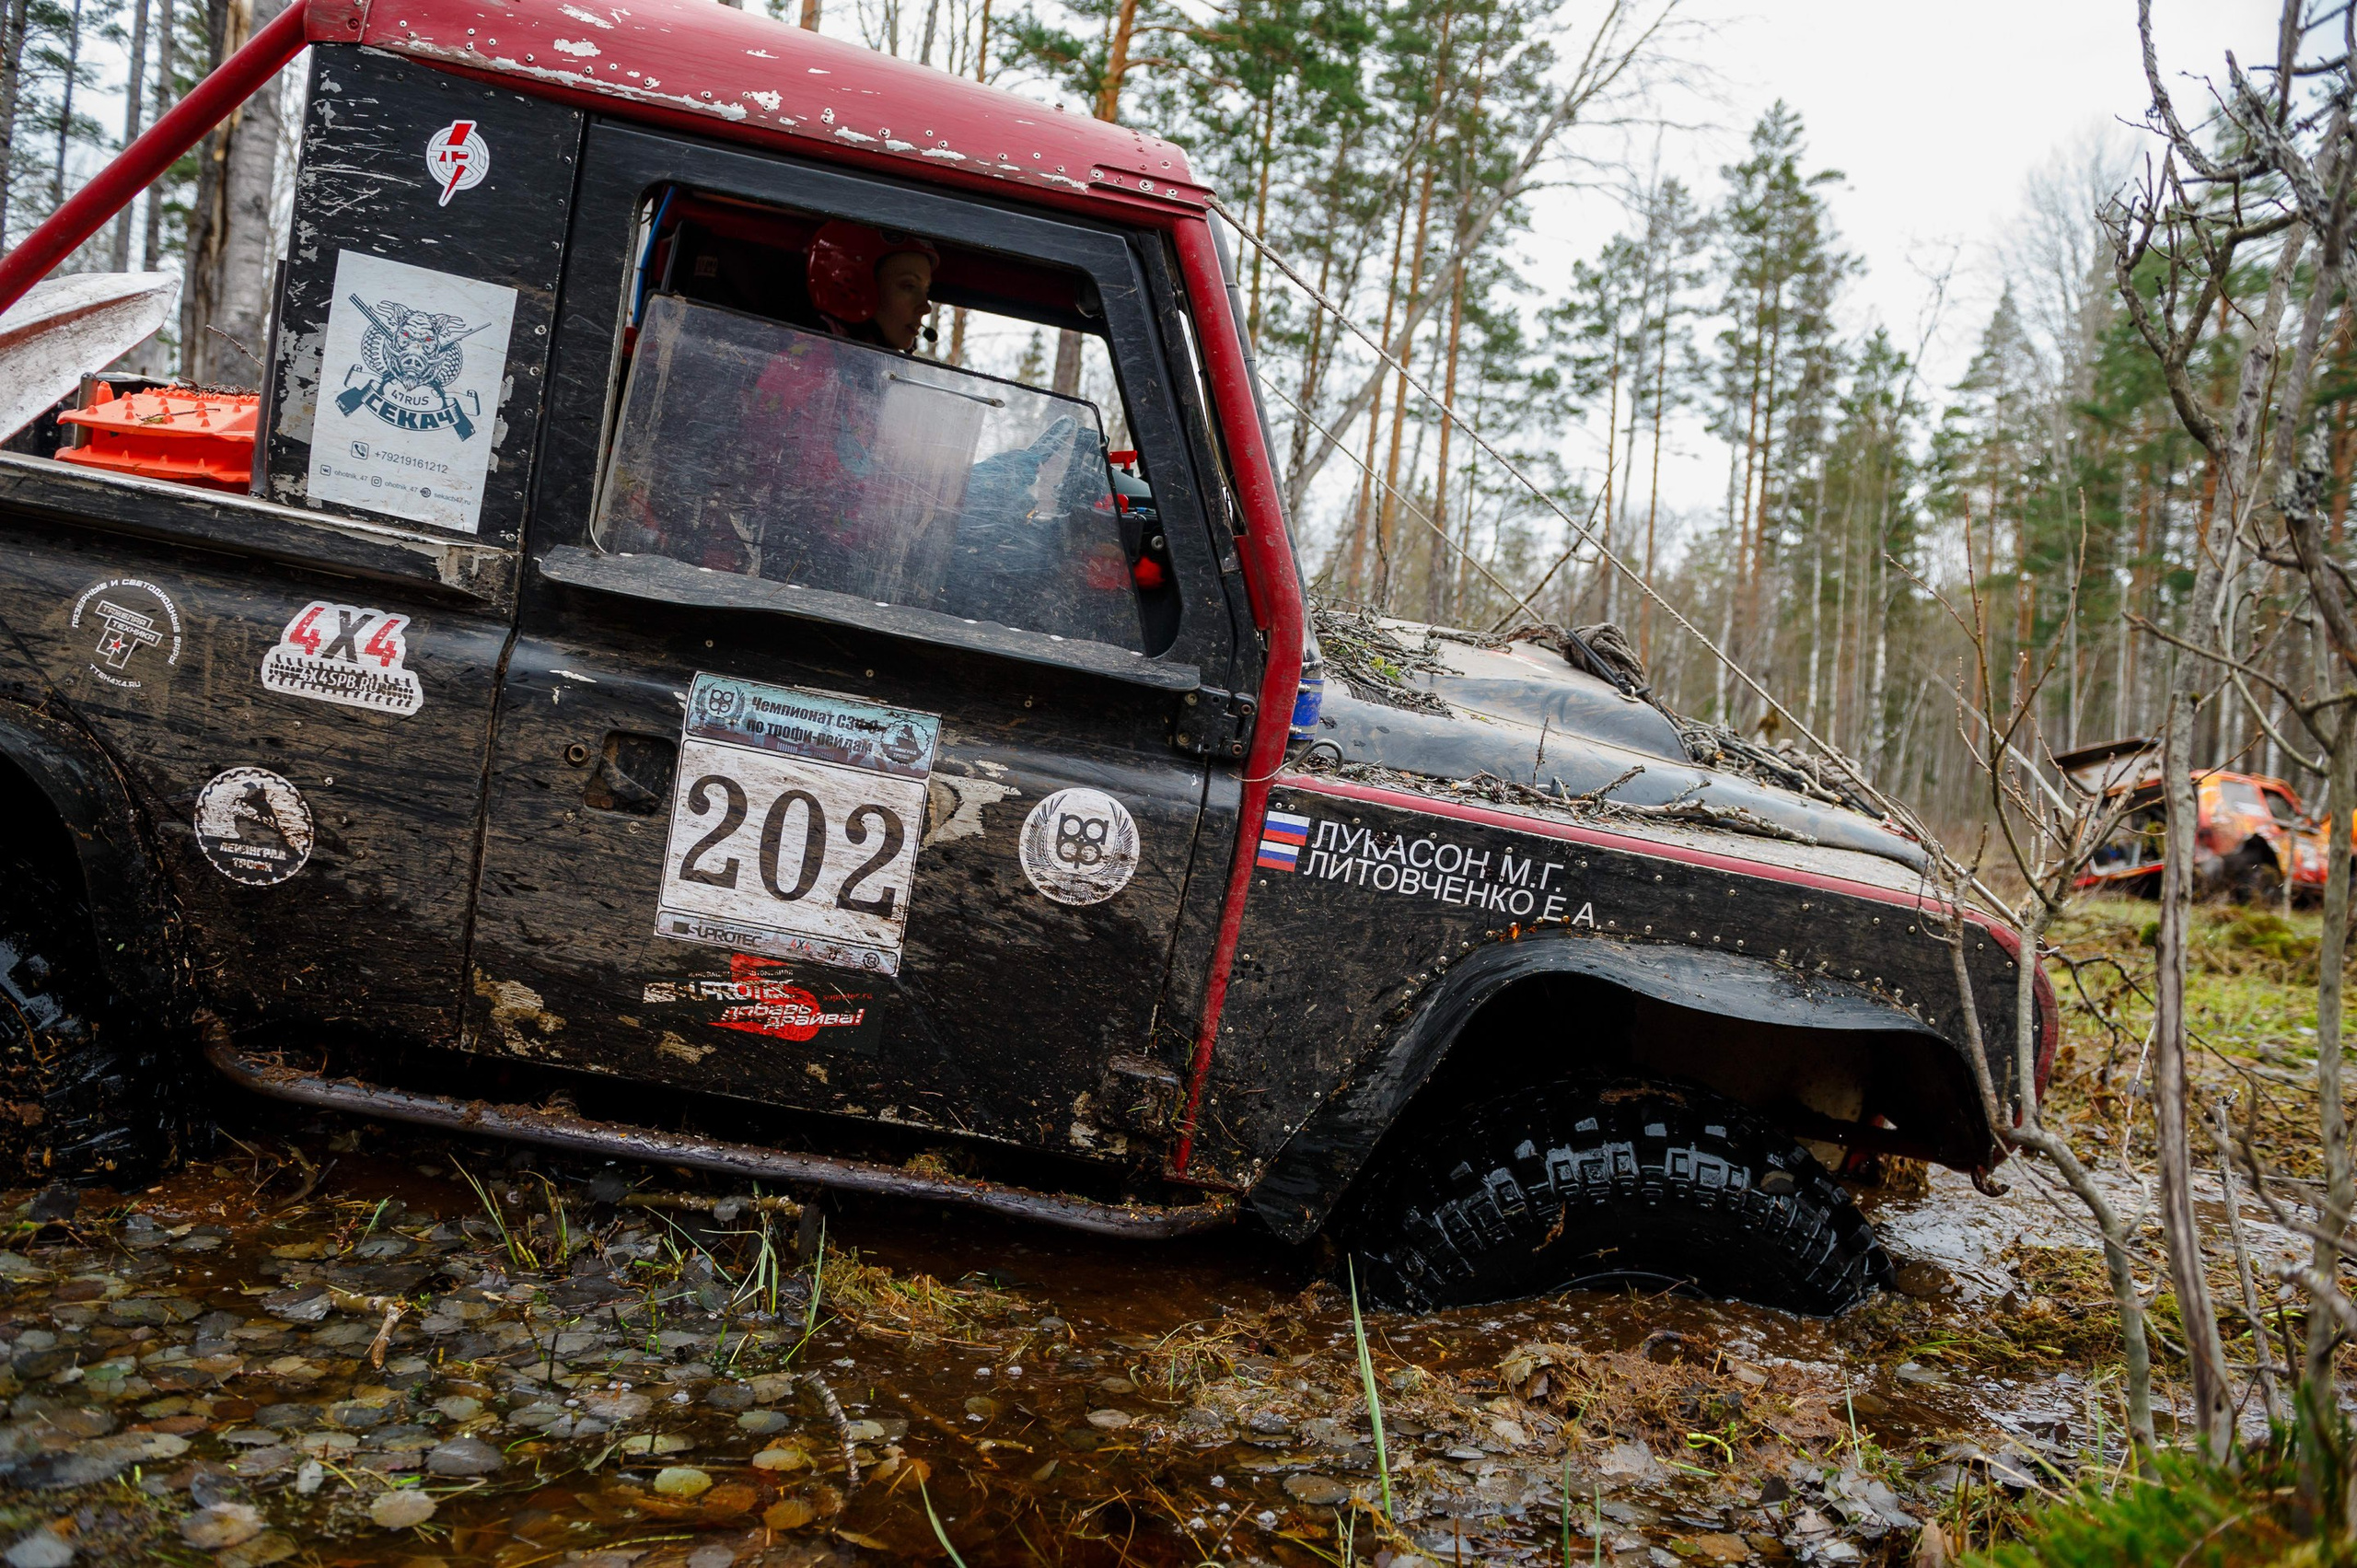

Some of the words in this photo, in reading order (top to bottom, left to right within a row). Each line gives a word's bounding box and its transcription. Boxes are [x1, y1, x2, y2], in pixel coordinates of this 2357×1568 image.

[365, 393, 456, 429] СЕКАЧ
[391, 389, 429, 406] 47RUS
[334, 469, 368, 482] ohotnik_47
[375, 450, 448, 474] +79219161212
[385, 481, 419, 494] ohotnik_47
[72, 582, 108, 628] ЛАЗЕРНЫЕ
[110, 579, 119, 587] И
[122, 578, 181, 633] СВЕТОДИОДНЫЕ
[168, 635, 181, 665] ФАРЫ
[102, 604, 147, 626] ТЯЖЕЛАЯ
[112, 620, 156, 642] ТЕХНИКА
[289, 607, 401, 668] 4X4
[299, 668, 379, 693] 4X4SPB.RU
[752, 696, 834, 726] Чемпионат
[747, 719, 764, 734] по
[767, 723, 873, 753] трофи-рейдам
[679, 774, 905, 918] 202
[1311, 819, 1491, 878] ЛУКАСОН
[1304, 851, 1534, 915] ЛИТОВЧЕНКО
[763, 1008, 865, 1030] драйва!
